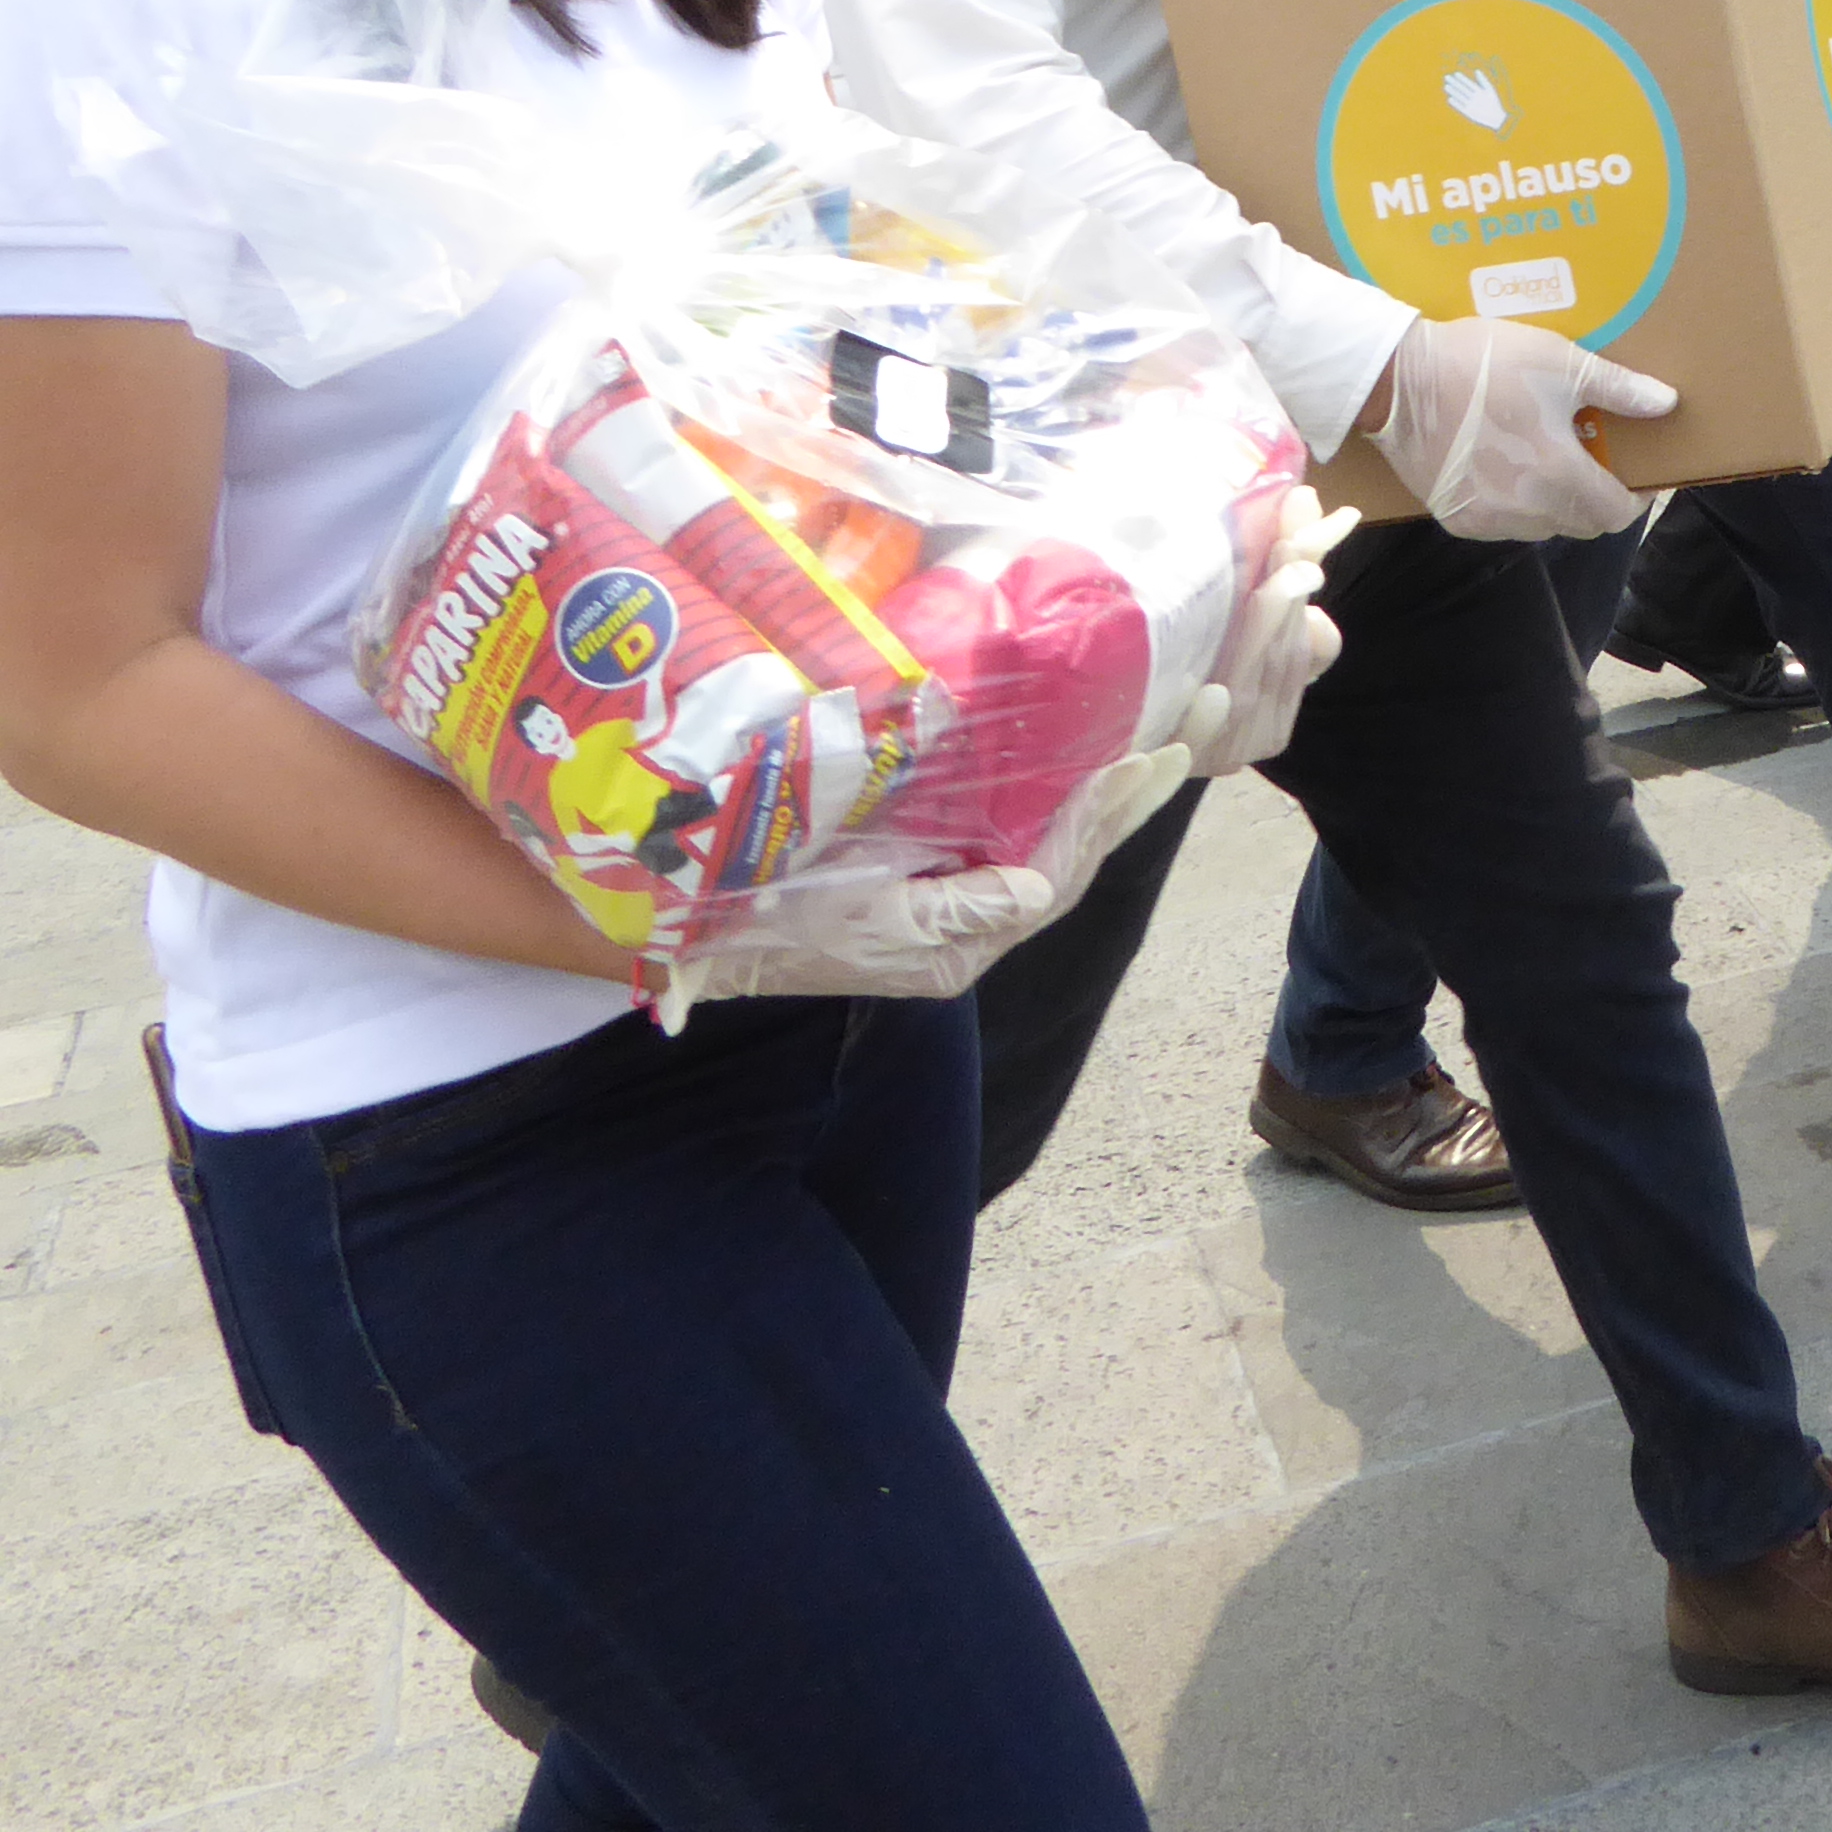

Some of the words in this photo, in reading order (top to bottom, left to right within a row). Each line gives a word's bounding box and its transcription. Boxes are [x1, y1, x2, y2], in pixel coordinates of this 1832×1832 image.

[1370, 173, 1430, 220] Mi
[1441, 153, 1633, 214] aplauso
[1430, 220, 1471, 247] es
[1479, 206, 1562, 247] para
[1569, 194, 1598, 227] ti
[611, 620, 657, 677] D
